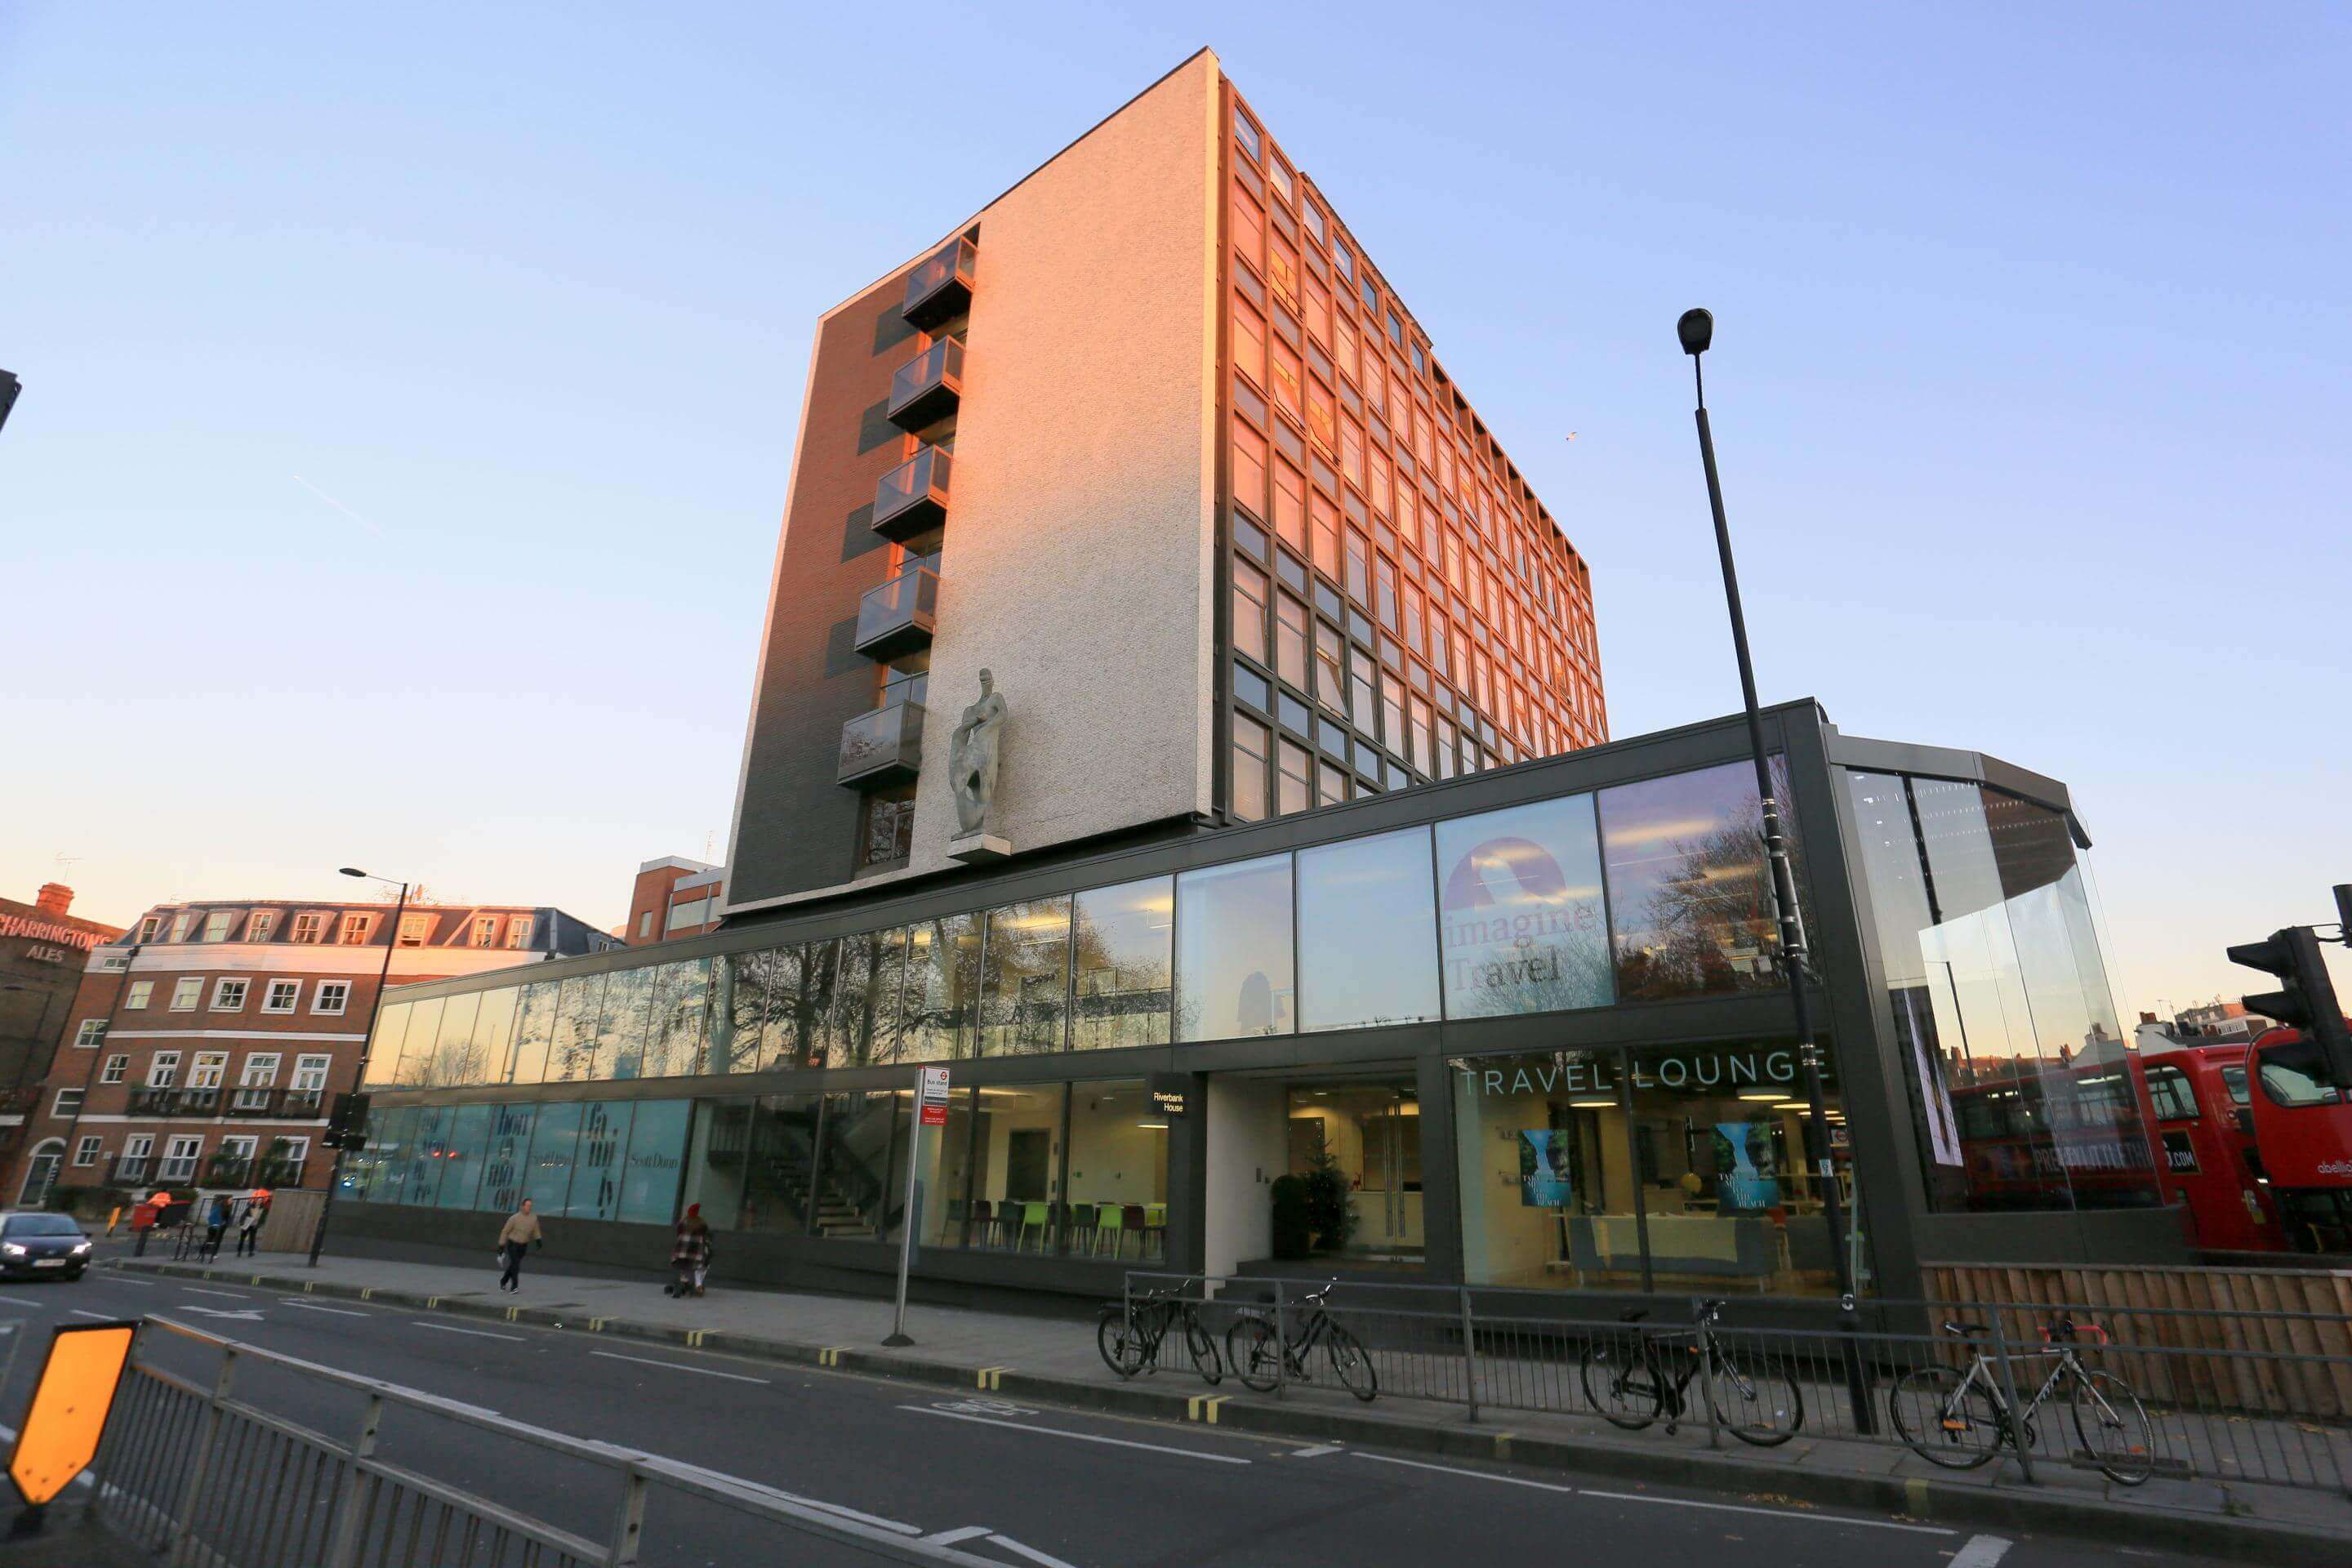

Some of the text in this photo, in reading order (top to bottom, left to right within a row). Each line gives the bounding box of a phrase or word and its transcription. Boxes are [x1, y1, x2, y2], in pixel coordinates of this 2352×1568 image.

[1446, 902, 1595, 948] imagine
[26, 945, 65, 962] ALES
[1449, 945, 1560, 991] Travel
[1460, 1064, 1612, 1096] TRAVEL
[1154, 1092, 1183, 1102] Riverbank
[1164, 1102, 1183, 1112] House
